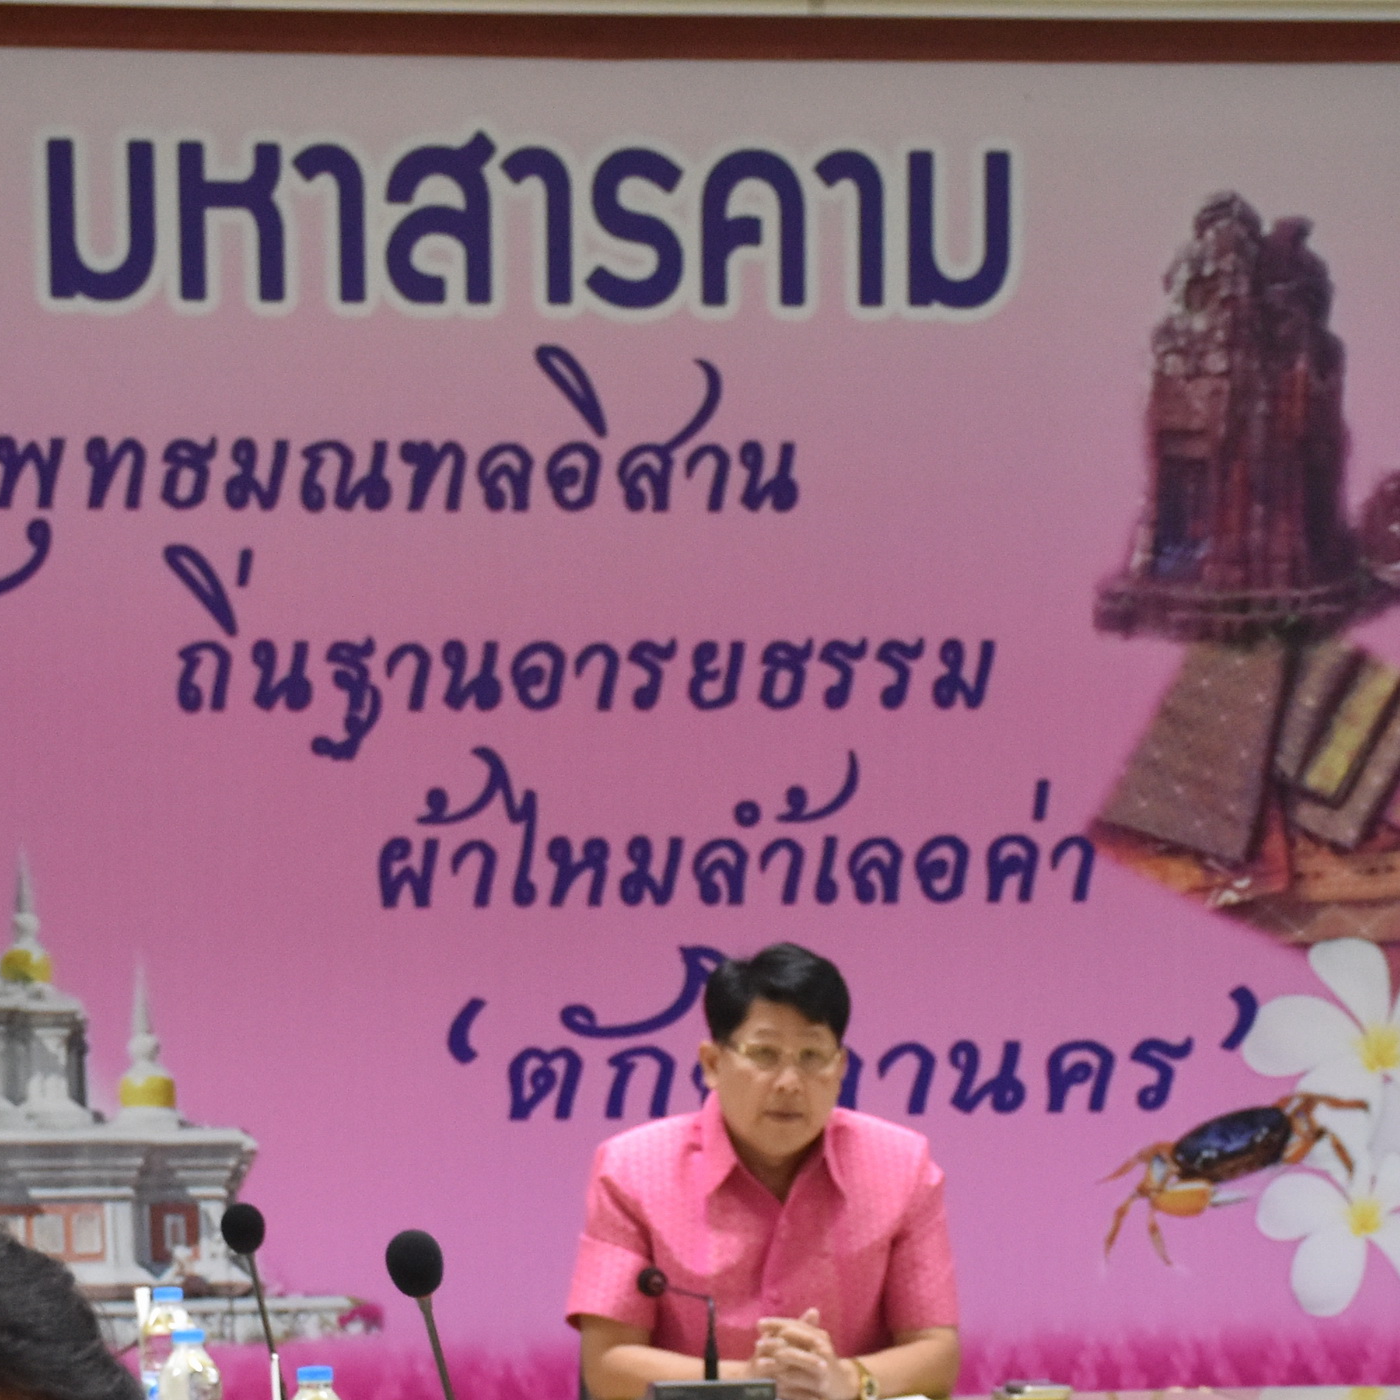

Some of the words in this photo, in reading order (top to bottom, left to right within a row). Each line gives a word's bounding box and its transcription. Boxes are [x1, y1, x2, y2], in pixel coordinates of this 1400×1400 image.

[45, 130, 1012, 309] มหาสารคาม
[163, 544, 996, 760] ถิ่นฐานอารยธรรม
[378, 746, 1096, 908] ผ้าไหมล้ำเลอค่า
